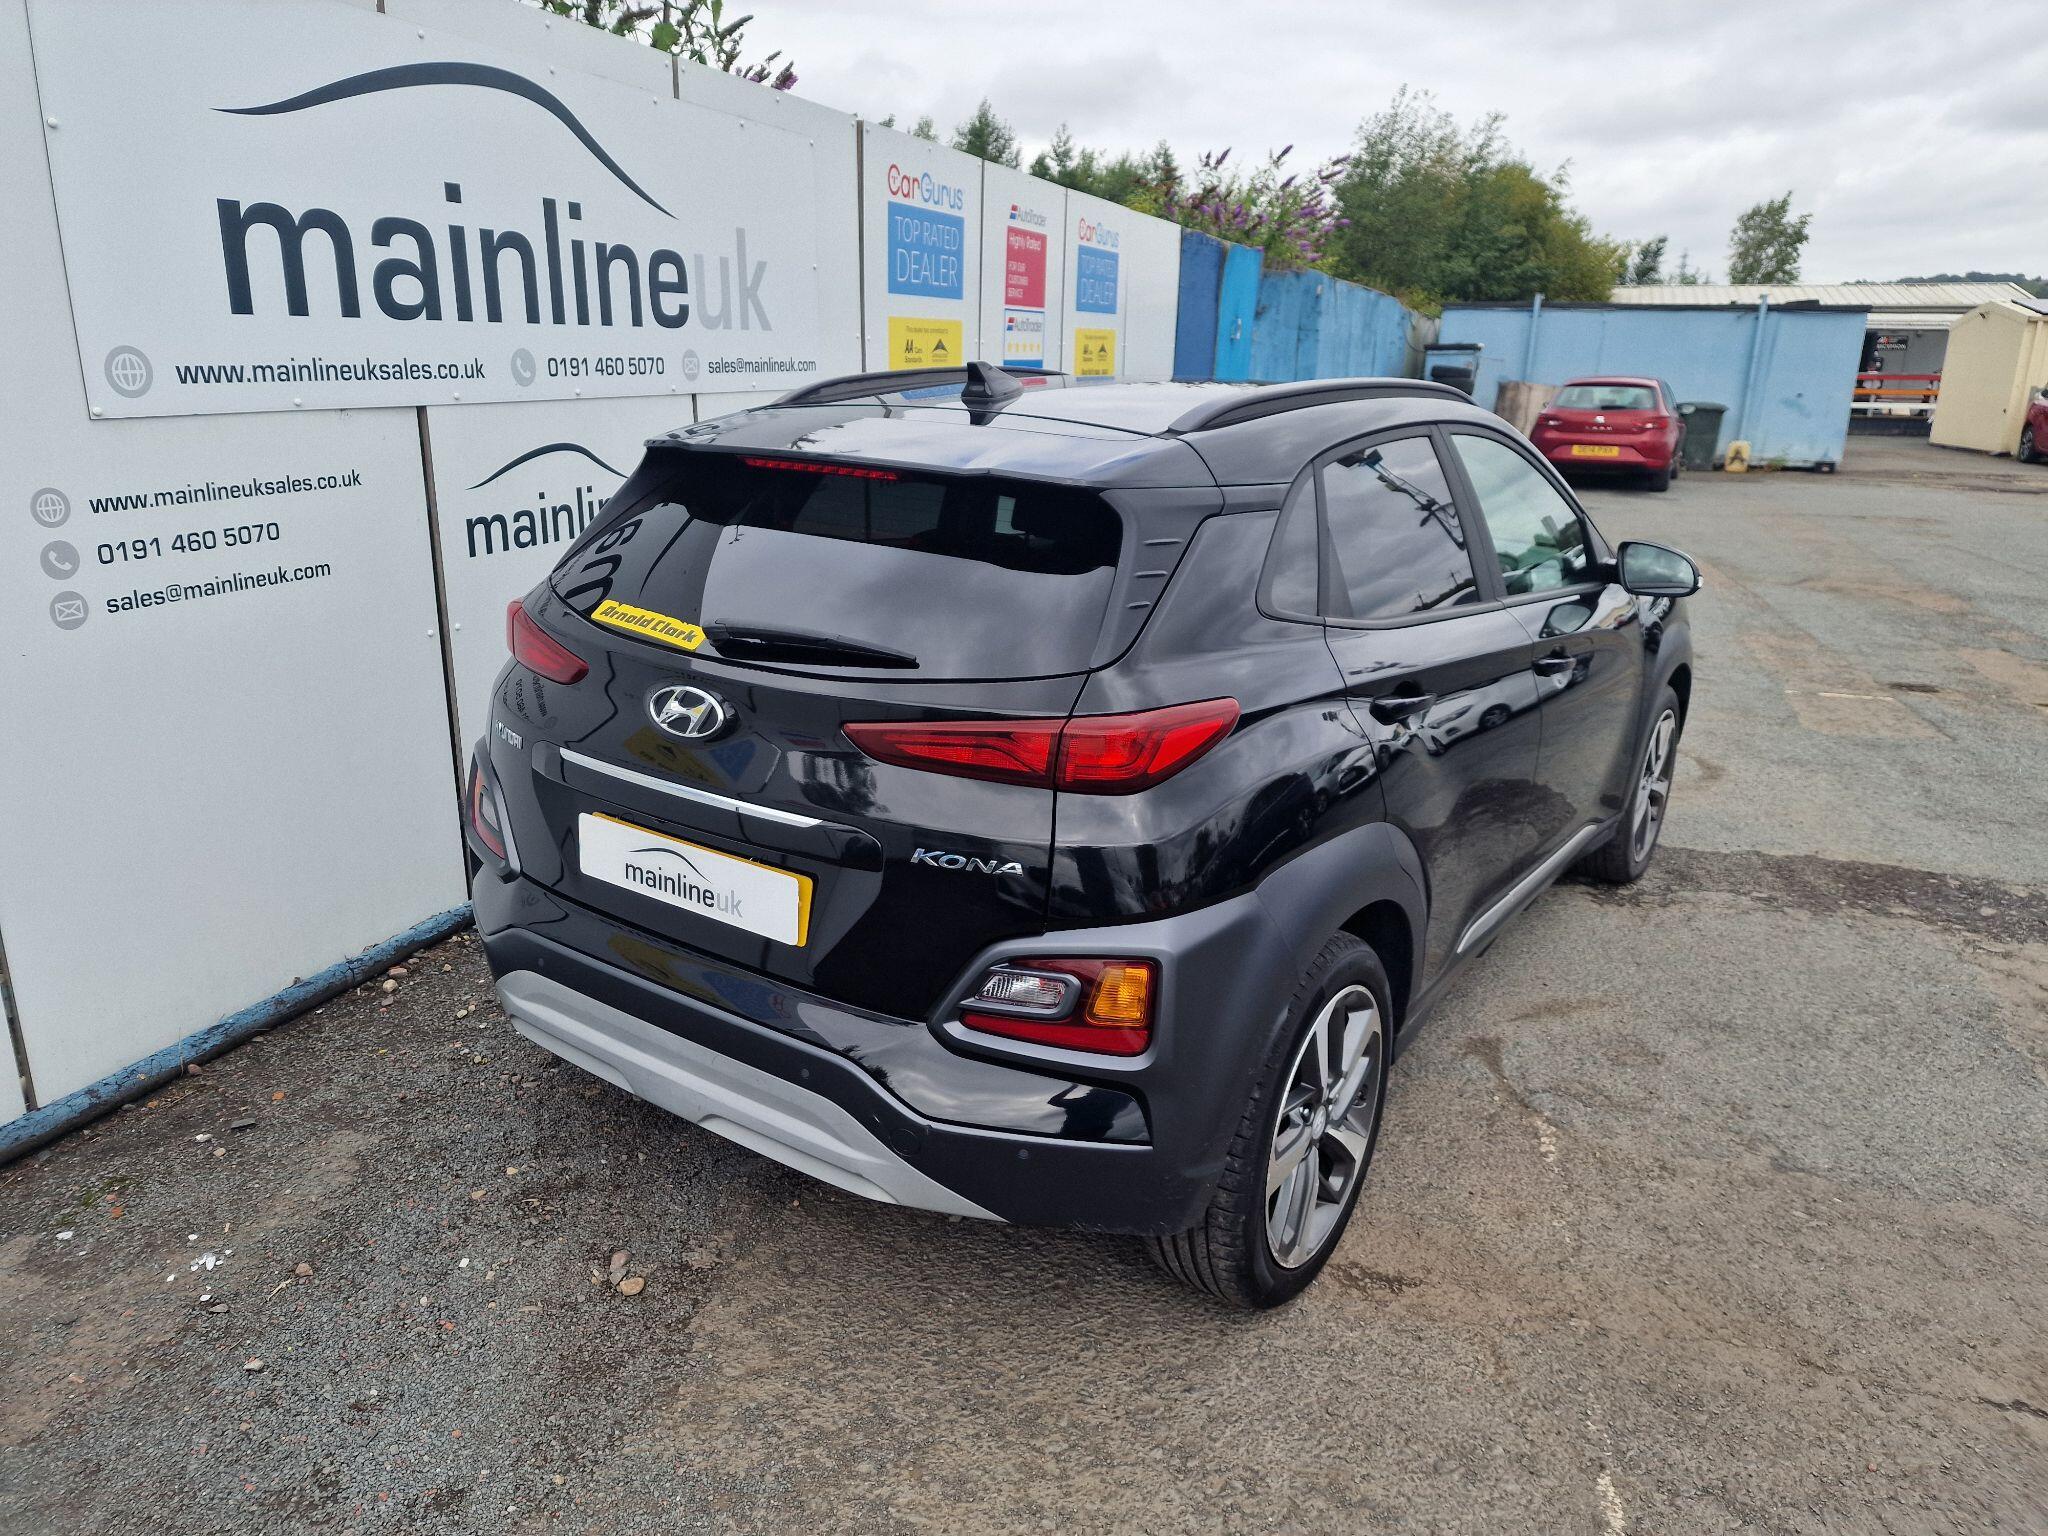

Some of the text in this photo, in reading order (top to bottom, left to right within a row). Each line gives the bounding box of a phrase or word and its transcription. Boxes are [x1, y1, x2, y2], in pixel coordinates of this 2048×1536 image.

[888, 164, 963, 210] CarGurus
[895, 216, 959, 250] TOP RATED
[217, 182, 773, 331] mainlineuk
[897, 248, 958, 287] DEALER
[175, 357, 486, 384] www.mainlineuksales.co.uk
[548, 357, 665, 377] 0191 460 5070
[708, 356, 817, 374] sales@mainlineuk.com
[88, 469, 362, 514] www.mainlineuksales.co.uk
[465, 485, 611, 558] mainli
[97, 522, 281, 565] 0191 460 5070
[106, 561, 331, 613] sales@mainlineuk.com
[599, 605, 698, 643] Arnold Clark
[910, 847, 1024, 877] KONA
[625, 862, 743, 919] mainlineuk
